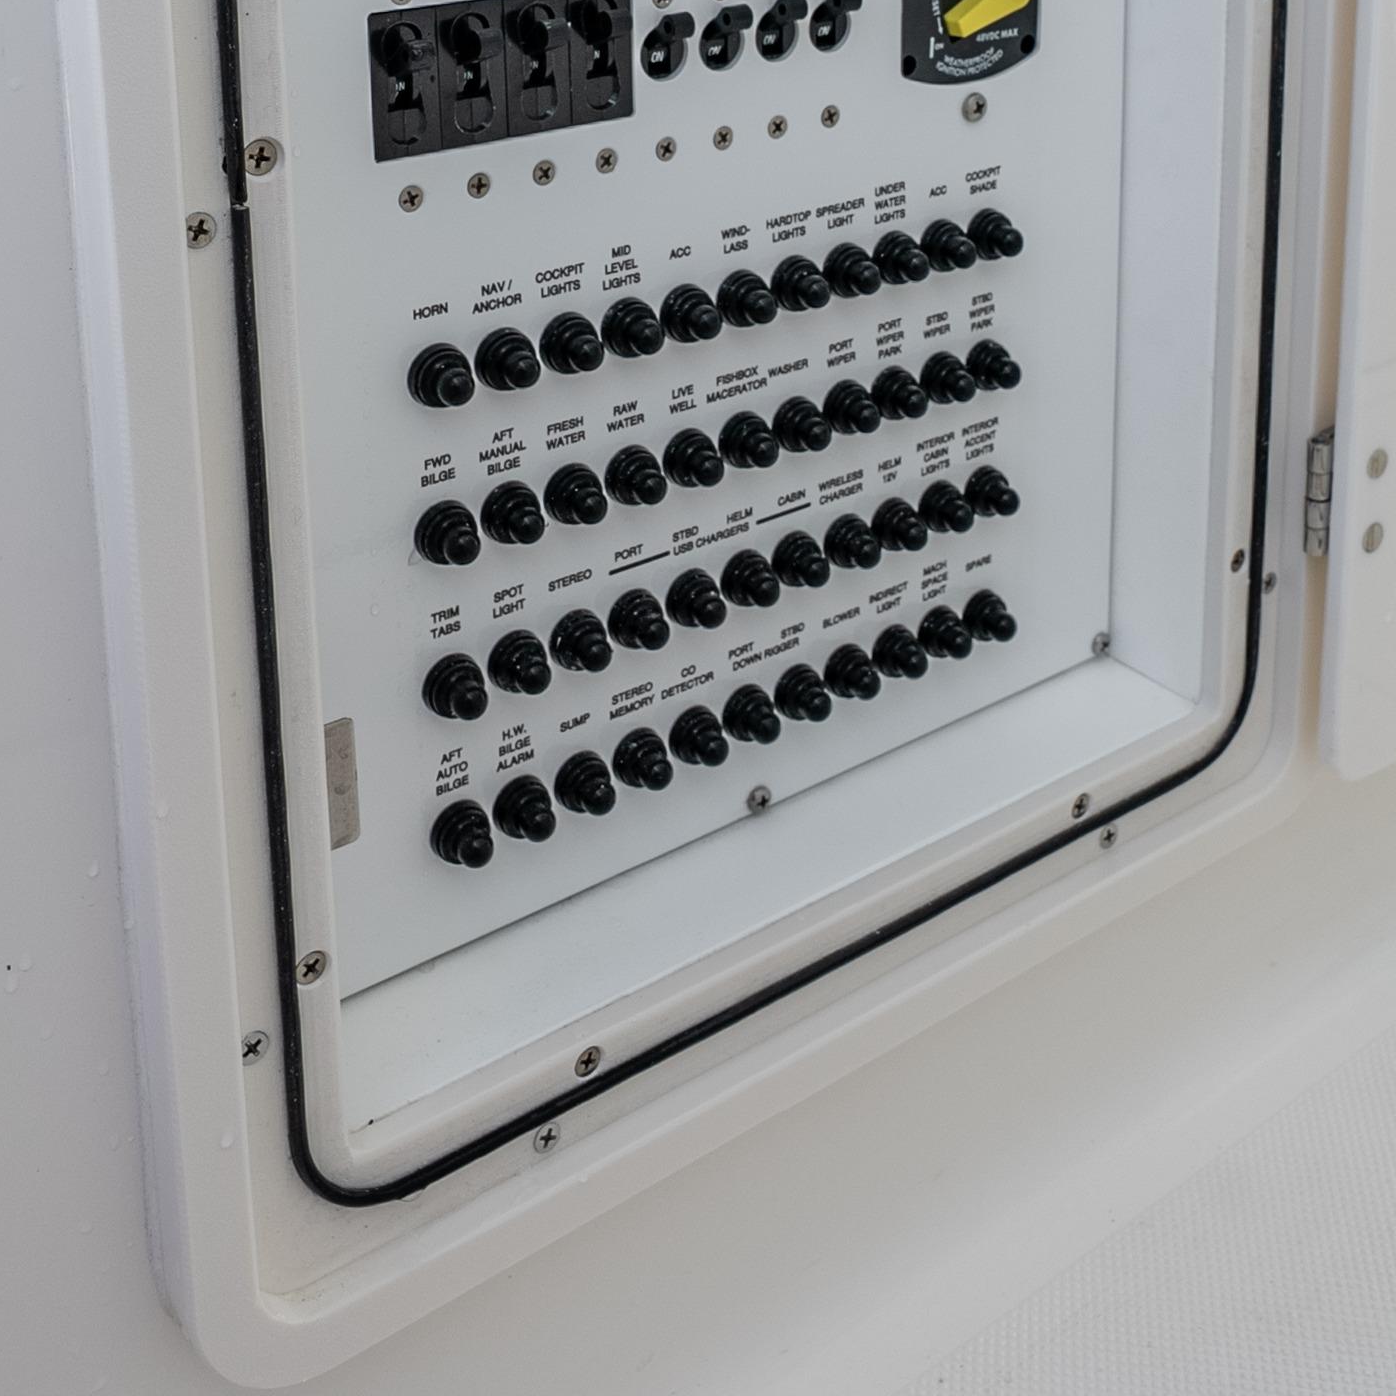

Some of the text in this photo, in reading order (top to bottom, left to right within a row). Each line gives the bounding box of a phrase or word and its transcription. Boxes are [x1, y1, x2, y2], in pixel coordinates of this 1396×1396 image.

[818, 25, 830, 36] ON
[763, 34, 777, 45] ON
[651, 51, 664, 62] ON
[708, 45, 721, 56] ON
[965, 166, 1001, 182] COCKPIT
[875, 181, 905, 197] UNDER
[970, 180, 997, 195] SHADE
[816, 198, 865, 218] SPREADER
[875, 195, 906, 210] WATER
[766, 210, 811, 229] HARDTOP
[828, 214, 854, 229] LIGHT
[874, 209, 905, 224] LIGHTS
[721, 225, 751, 240] WIND-
[772, 226, 806, 243] LIGHTS
[612, 245, 631, 258] MID
[669, 246, 691, 260] ACC
[724, 240, 748, 254] LASS
[535, 263, 585, 284] COCKPIT
[605, 259, 638, 275] LEVEL
[481, 281, 505, 296] NAV
[541, 279, 581, 298] LIGHTS
[602, 273, 641, 291] LIGHTS
[413, 303, 448, 320] HORN
[472, 293, 522, 315] ANCHOR
[969, 304, 995, 319] WIPER
[878, 318, 902, 333] PORT
[923, 324, 950, 339] WIPER
[971, 318, 993, 332] PARK
[829, 338, 854, 354] PORT
[876, 331, 904, 346] WIPER
[827, 352, 856, 368] WIPER
[878, 344, 902, 360] PARK
[716, 366, 758, 386] FISHBOX
[768, 359, 809, 378] WASHER
[672, 384, 694, 400] LIVE
[706, 378, 767, 404] MACERATOR
[613, 400, 638, 416] RAW
[669, 399, 697, 415] WELL
[547, 416, 584, 436] FRESH
[607, 413, 645, 433] WATER
[492, 428, 514, 443] AFT
[546, 431, 585, 450] WATER
[917, 432, 955, 452] INTERIOR
[479, 440, 526, 463] MANUAL
[424, 454, 451, 471] FWD
[488, 456, 521, 476] BILGE
[878, 456, 902, 472] HELM
[421, 468, 456, 487] BILGE
[819, 469, 863, 492] WIRELESS
[778, 490, 806, 506] CABIN
[819, 483, 863, 505] CHARGER
[727, 507, 753, 524] HELM
[673, 526, 699, 542] STBD
[673, 523, 749, 556] USB CHARGERS
[614, 544, 643, 563] PORT
[548, 569, 593, 592] STEREO
[494, 584, 524, 603] SPOT
[431, 605, 460, 624] TRIM
[493, 598, 526, 619] LIGHT
[823, 607, 860, 628] BLOWER
[430, 621, 461, 640] TABS
[729, 642, 754, 659] PORT
[612, 682, 653, 705] STEREO
[661, 671, 714, 700] DETECTOR
[610, 694, 655, 720] MEMORY
[560, 713, 590, 732] SUMP
[502, 724, 526, 741] H.W.
[499, 736, 531, 757] BILGE
[441, 748, 463, 765] AFT
[496, 749, 534, 772] ALARM
[436, 762, 468, 781] AUTO
[436, 775, 469, 796] BILGE
